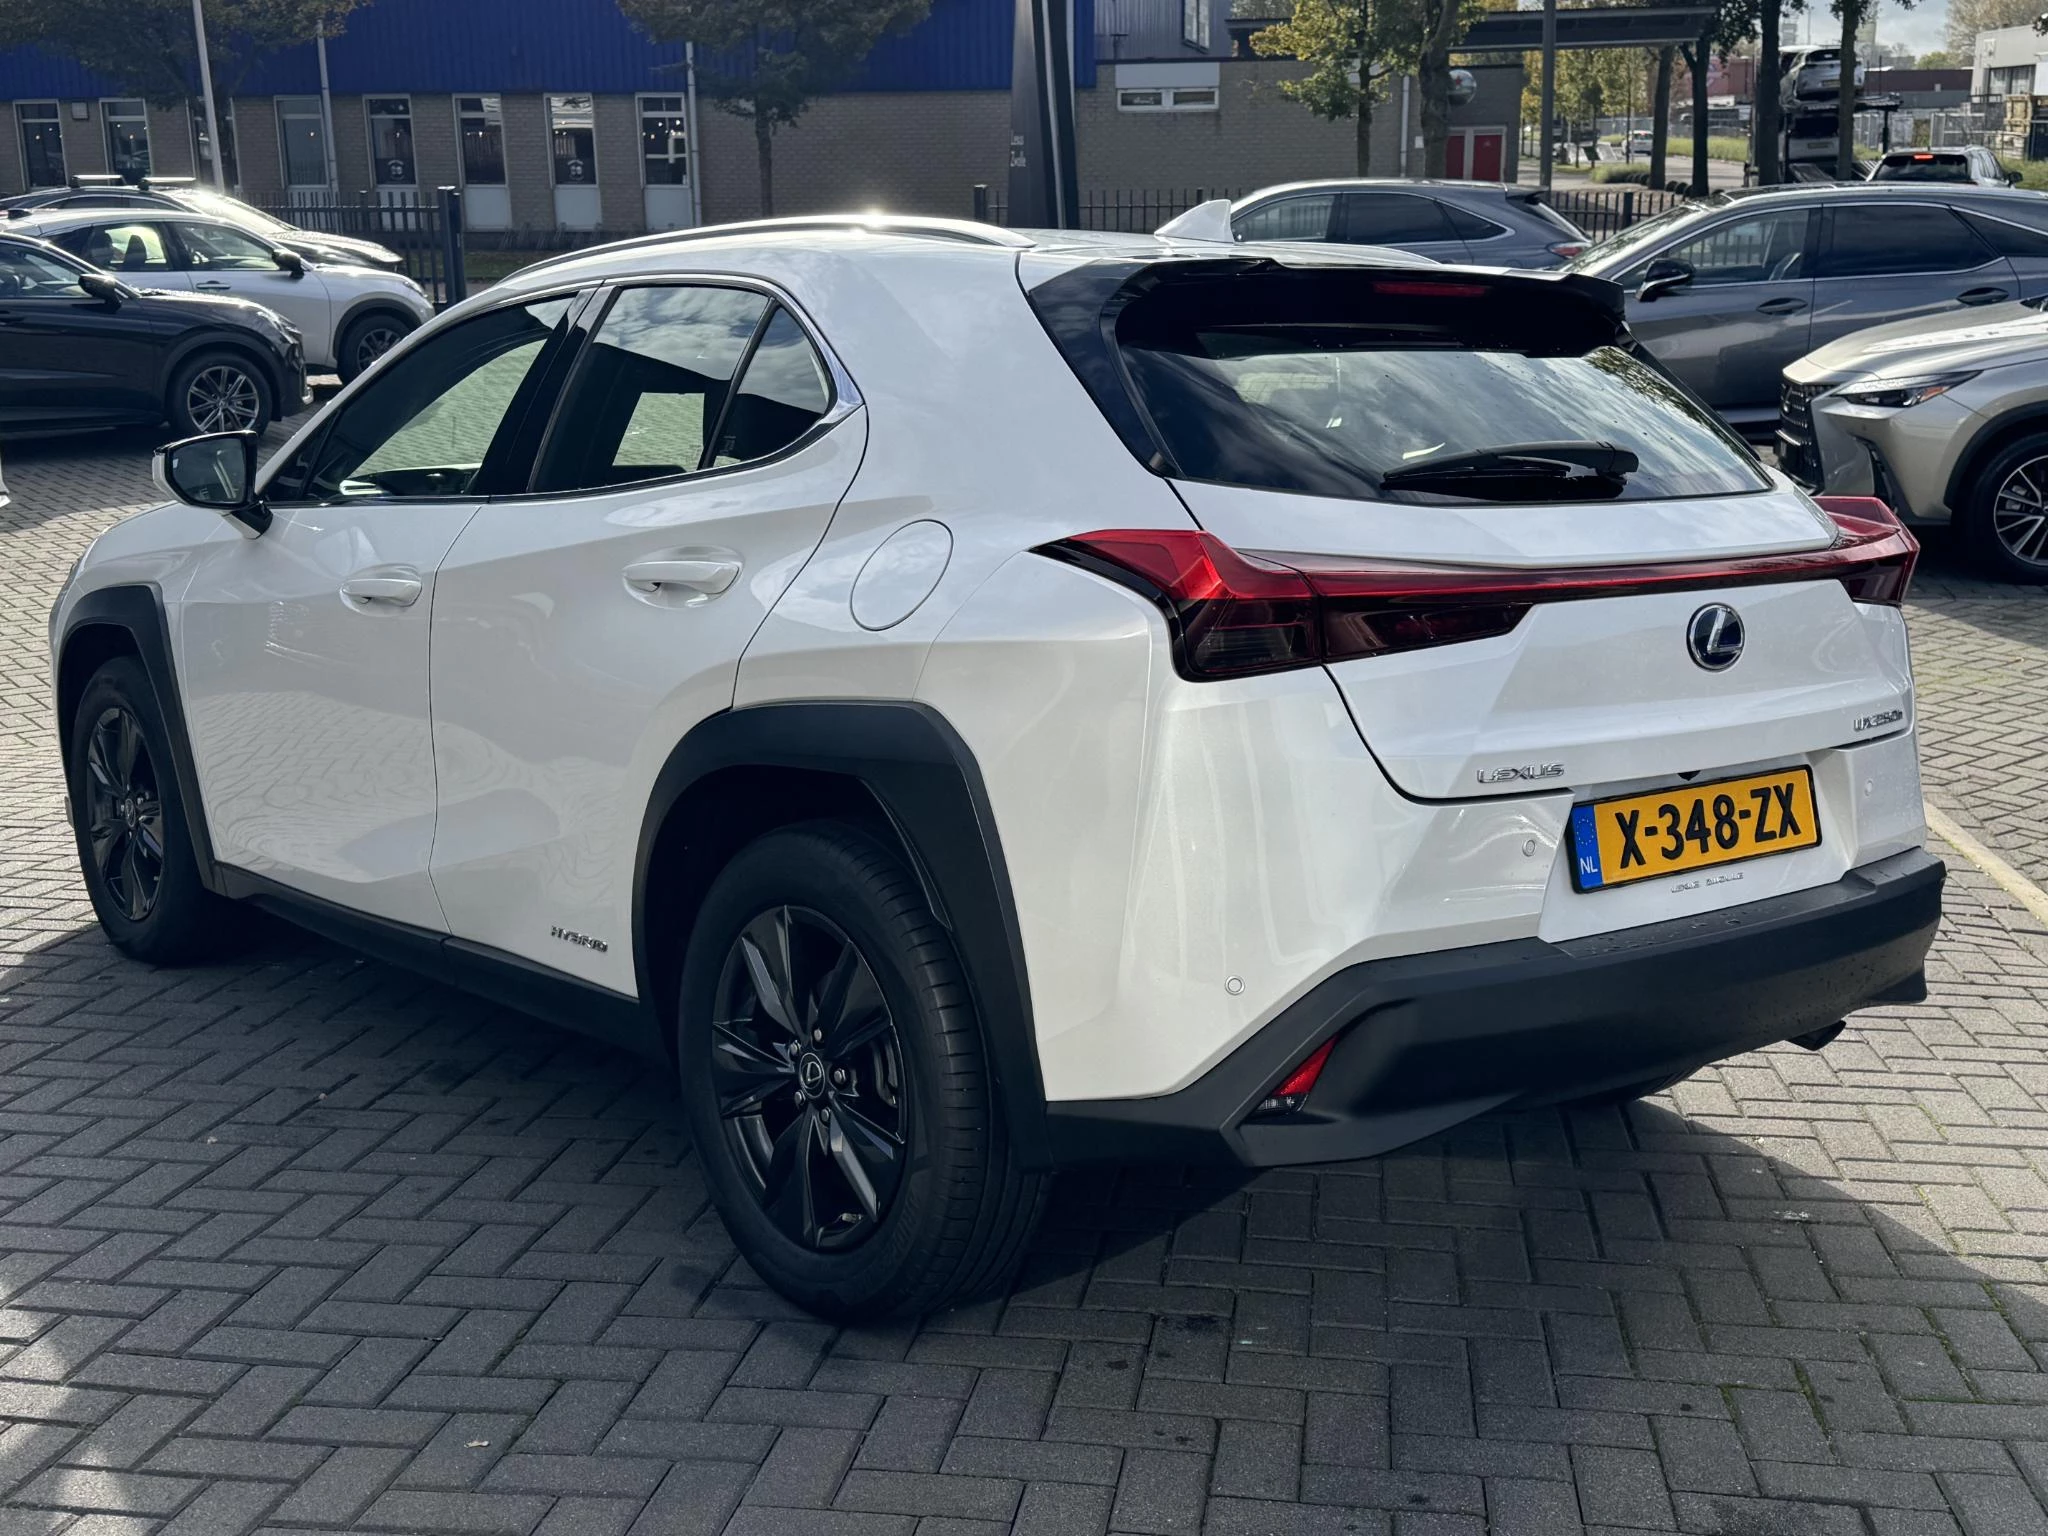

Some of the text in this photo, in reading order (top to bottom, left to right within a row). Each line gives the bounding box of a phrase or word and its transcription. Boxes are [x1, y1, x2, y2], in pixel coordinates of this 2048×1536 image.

[1476, 763, 1565, 784] LEXUS
[1614, 782, 1802, 870] X-348-ZX
[1579, 858, 1599, 876] NL
[551, 925, 609, 953] HYBRID
